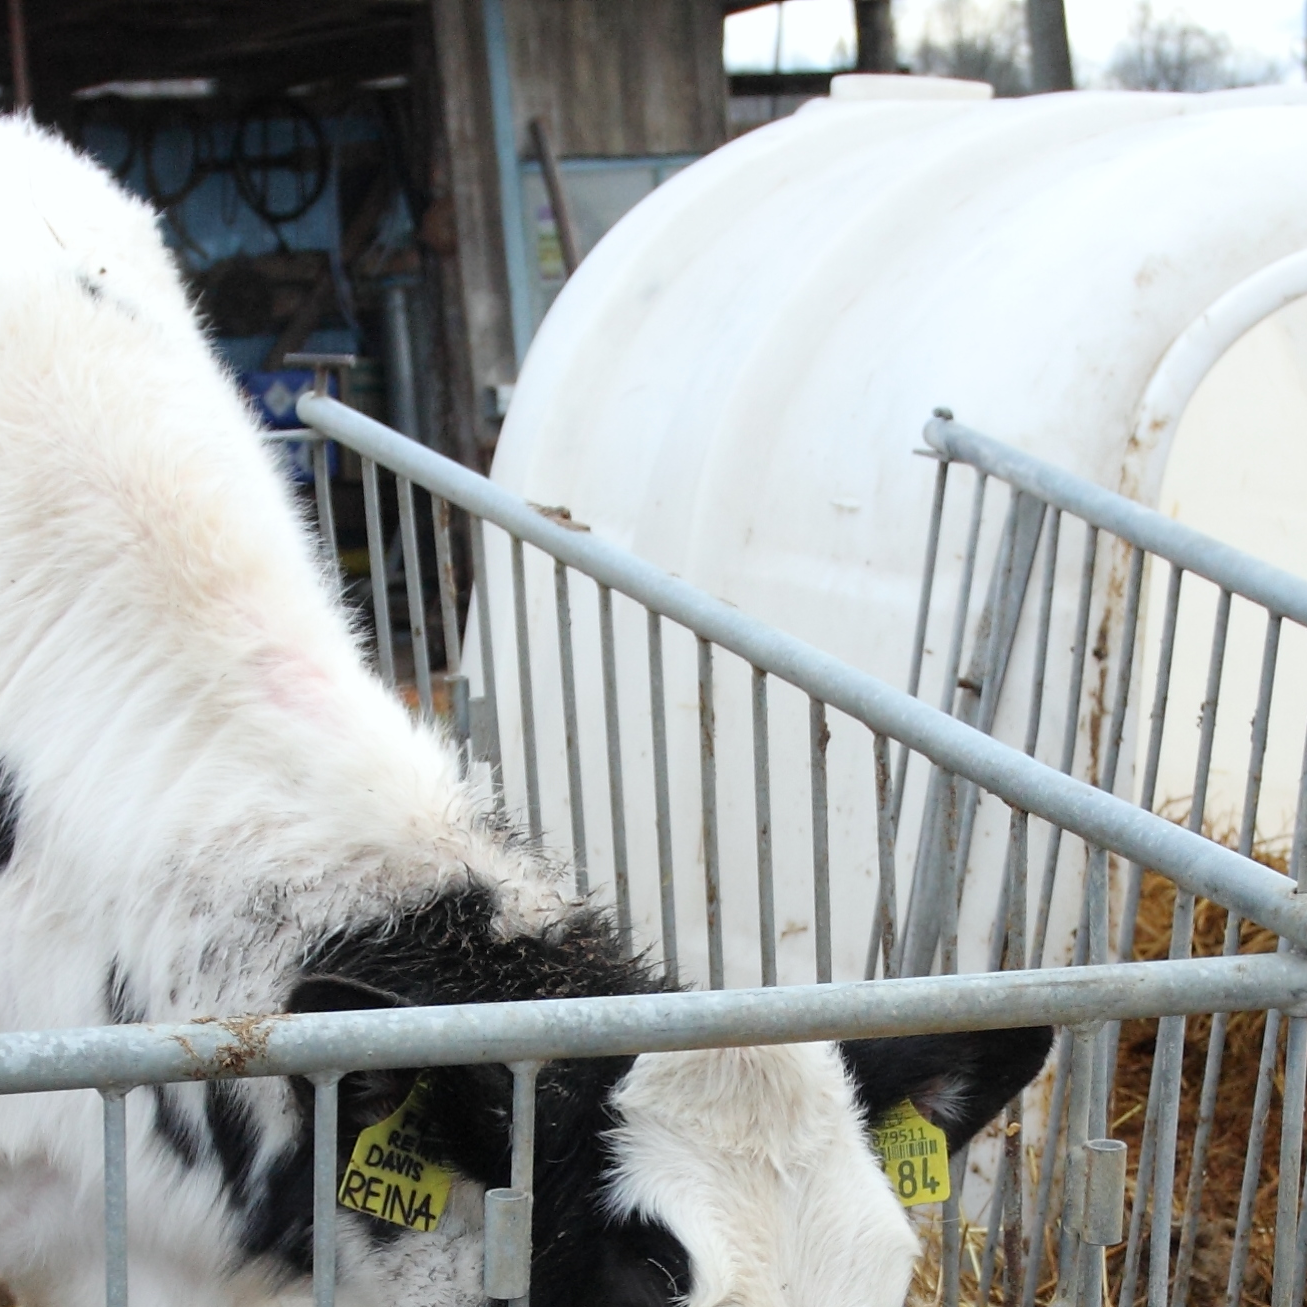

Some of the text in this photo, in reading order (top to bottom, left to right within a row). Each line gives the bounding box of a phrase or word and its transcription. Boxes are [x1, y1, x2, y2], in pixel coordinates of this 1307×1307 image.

[364, 1143, 425, 1182] DAVIS
[897, 1156, 941, 1199] 84
[340, 1169, 437, 1232] REINA
